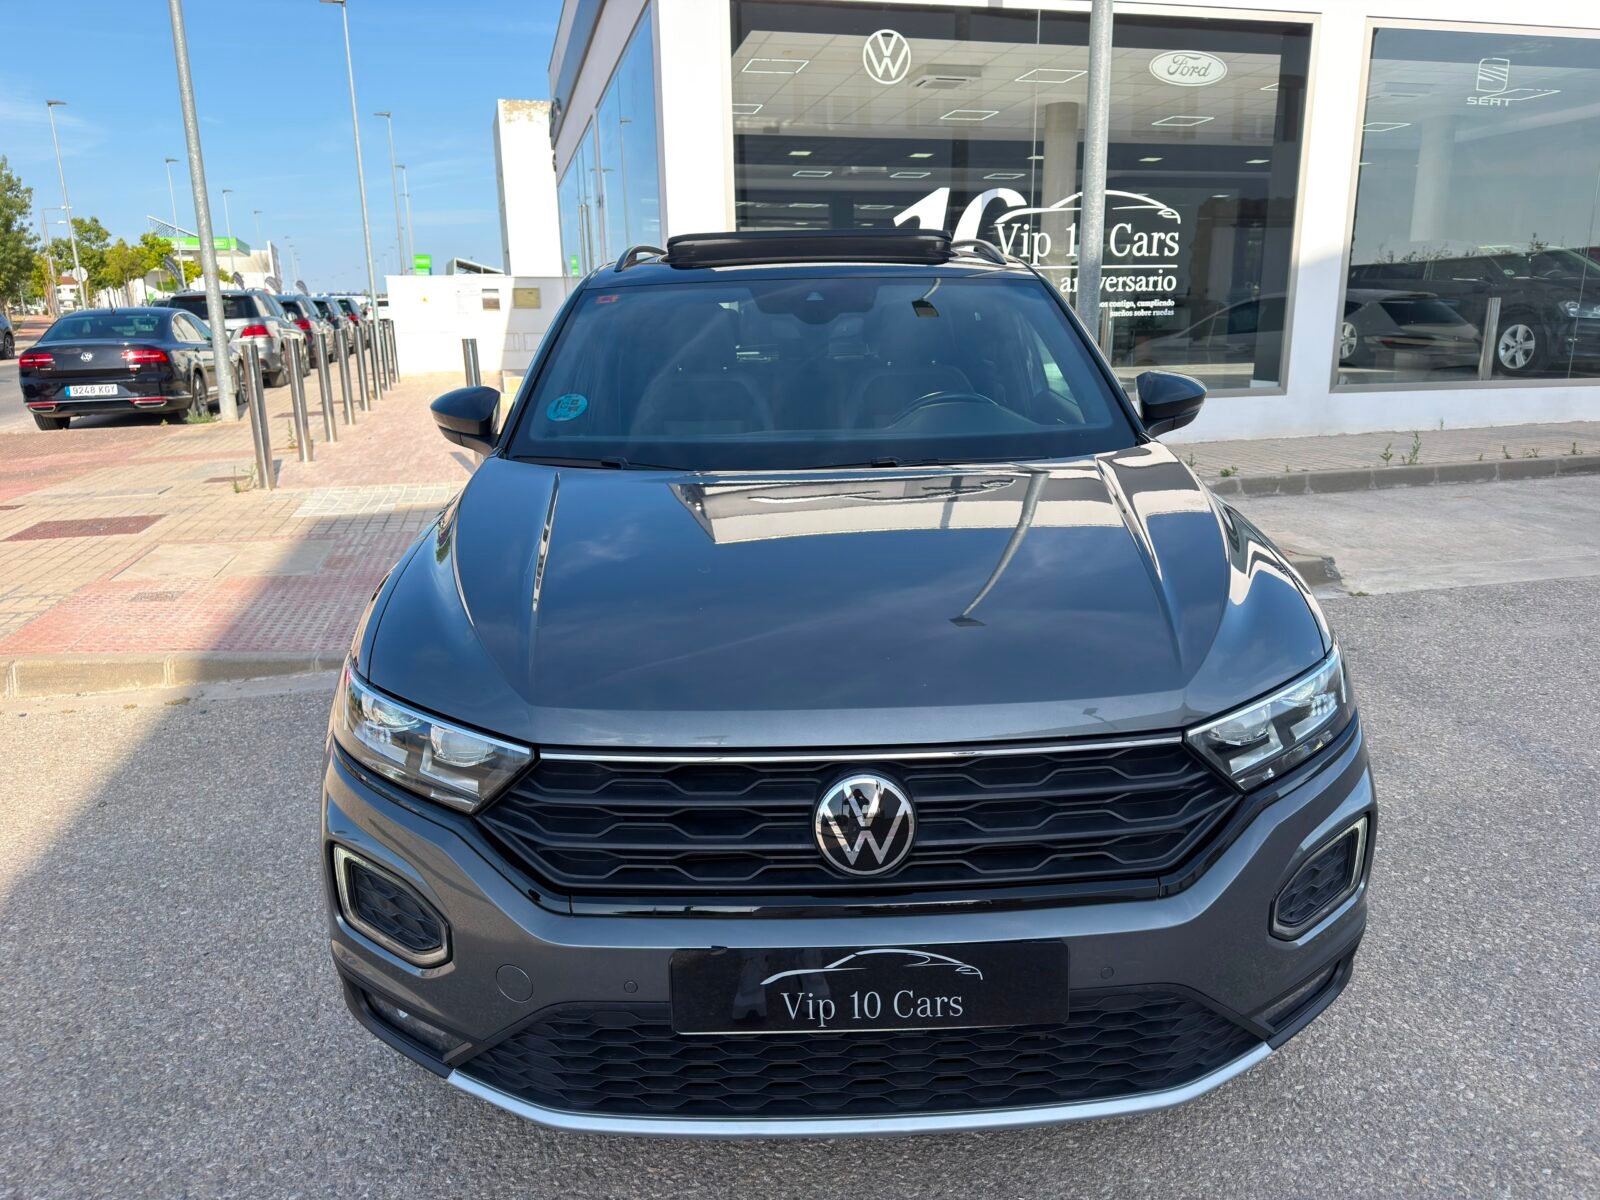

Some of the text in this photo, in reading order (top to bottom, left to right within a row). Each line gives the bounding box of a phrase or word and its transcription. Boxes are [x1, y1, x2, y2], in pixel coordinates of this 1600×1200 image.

[1167, 54, 1212, 77] Ford
[1466, 96, 1510, 106] SEAT
[995, 223, 1051, 266] Vip
[1109, 222, 1180, 257] Cars
[1153, 308, 1174, 316] ruedas
[72, 385, 115, 395] 9248 KGY
[780, 989, 963, 1028] Vip 10 Cars
